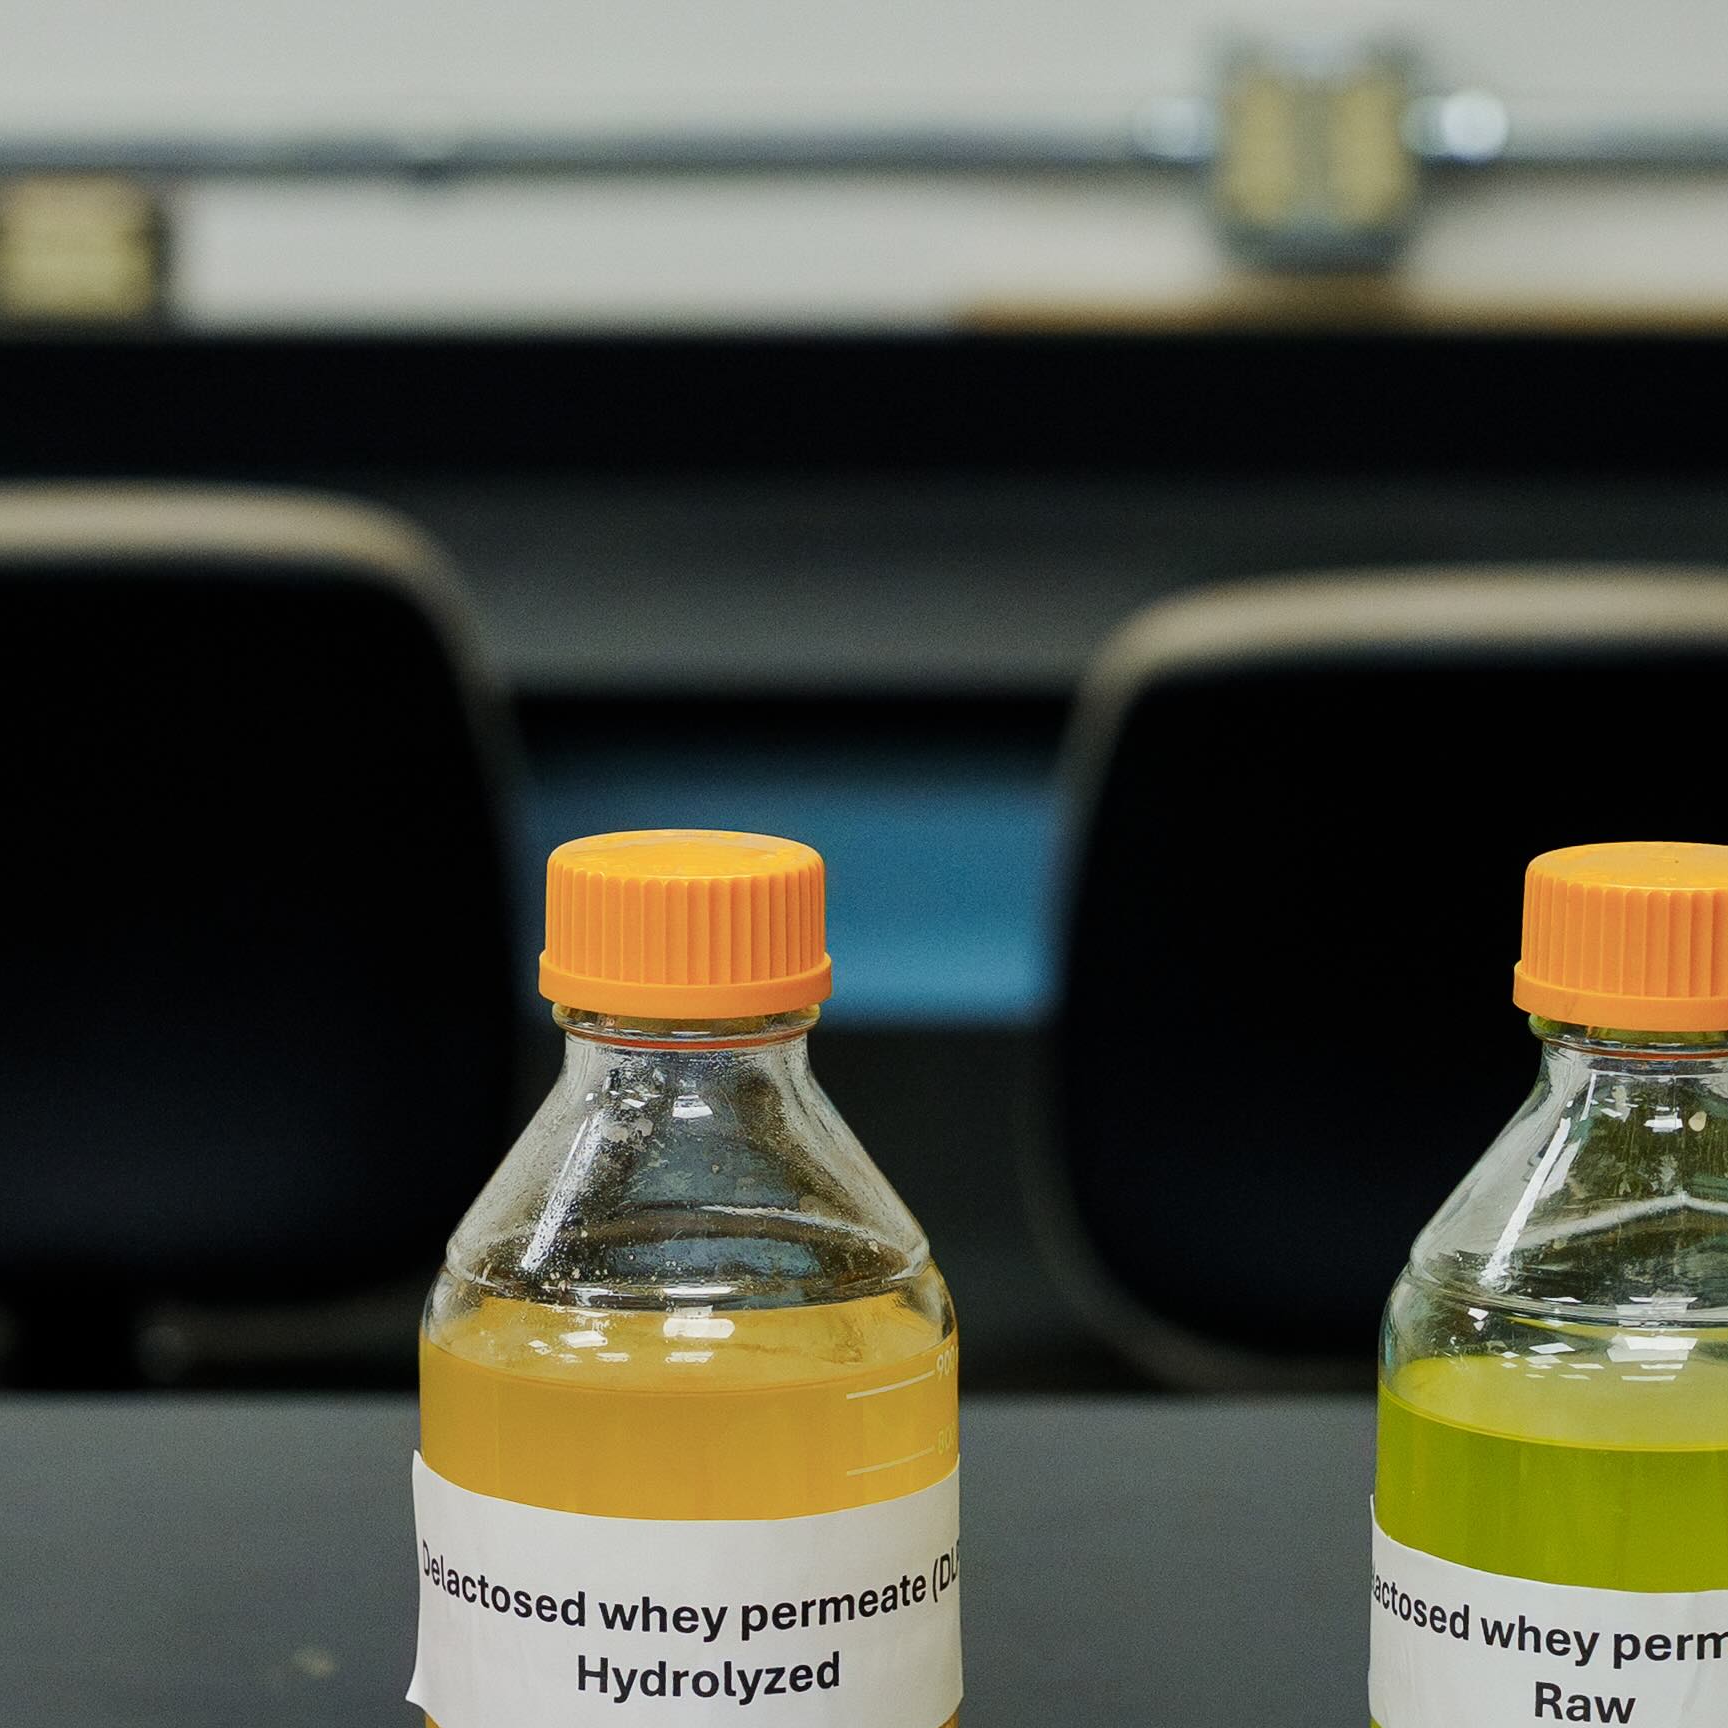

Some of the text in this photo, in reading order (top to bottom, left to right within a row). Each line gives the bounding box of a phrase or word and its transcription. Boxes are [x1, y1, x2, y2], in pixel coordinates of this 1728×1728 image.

[423, 1539, 586, 1627] Delactosed
[598, 1596, 728, 1643] whey
[741, 1574, 926, 1641] permeate
[1480, 1615, 1600, 1667] whey
[578, 1651, 840, 1706] Hydrolyzed
[1535, 1681, 1636, 1724] Raw
